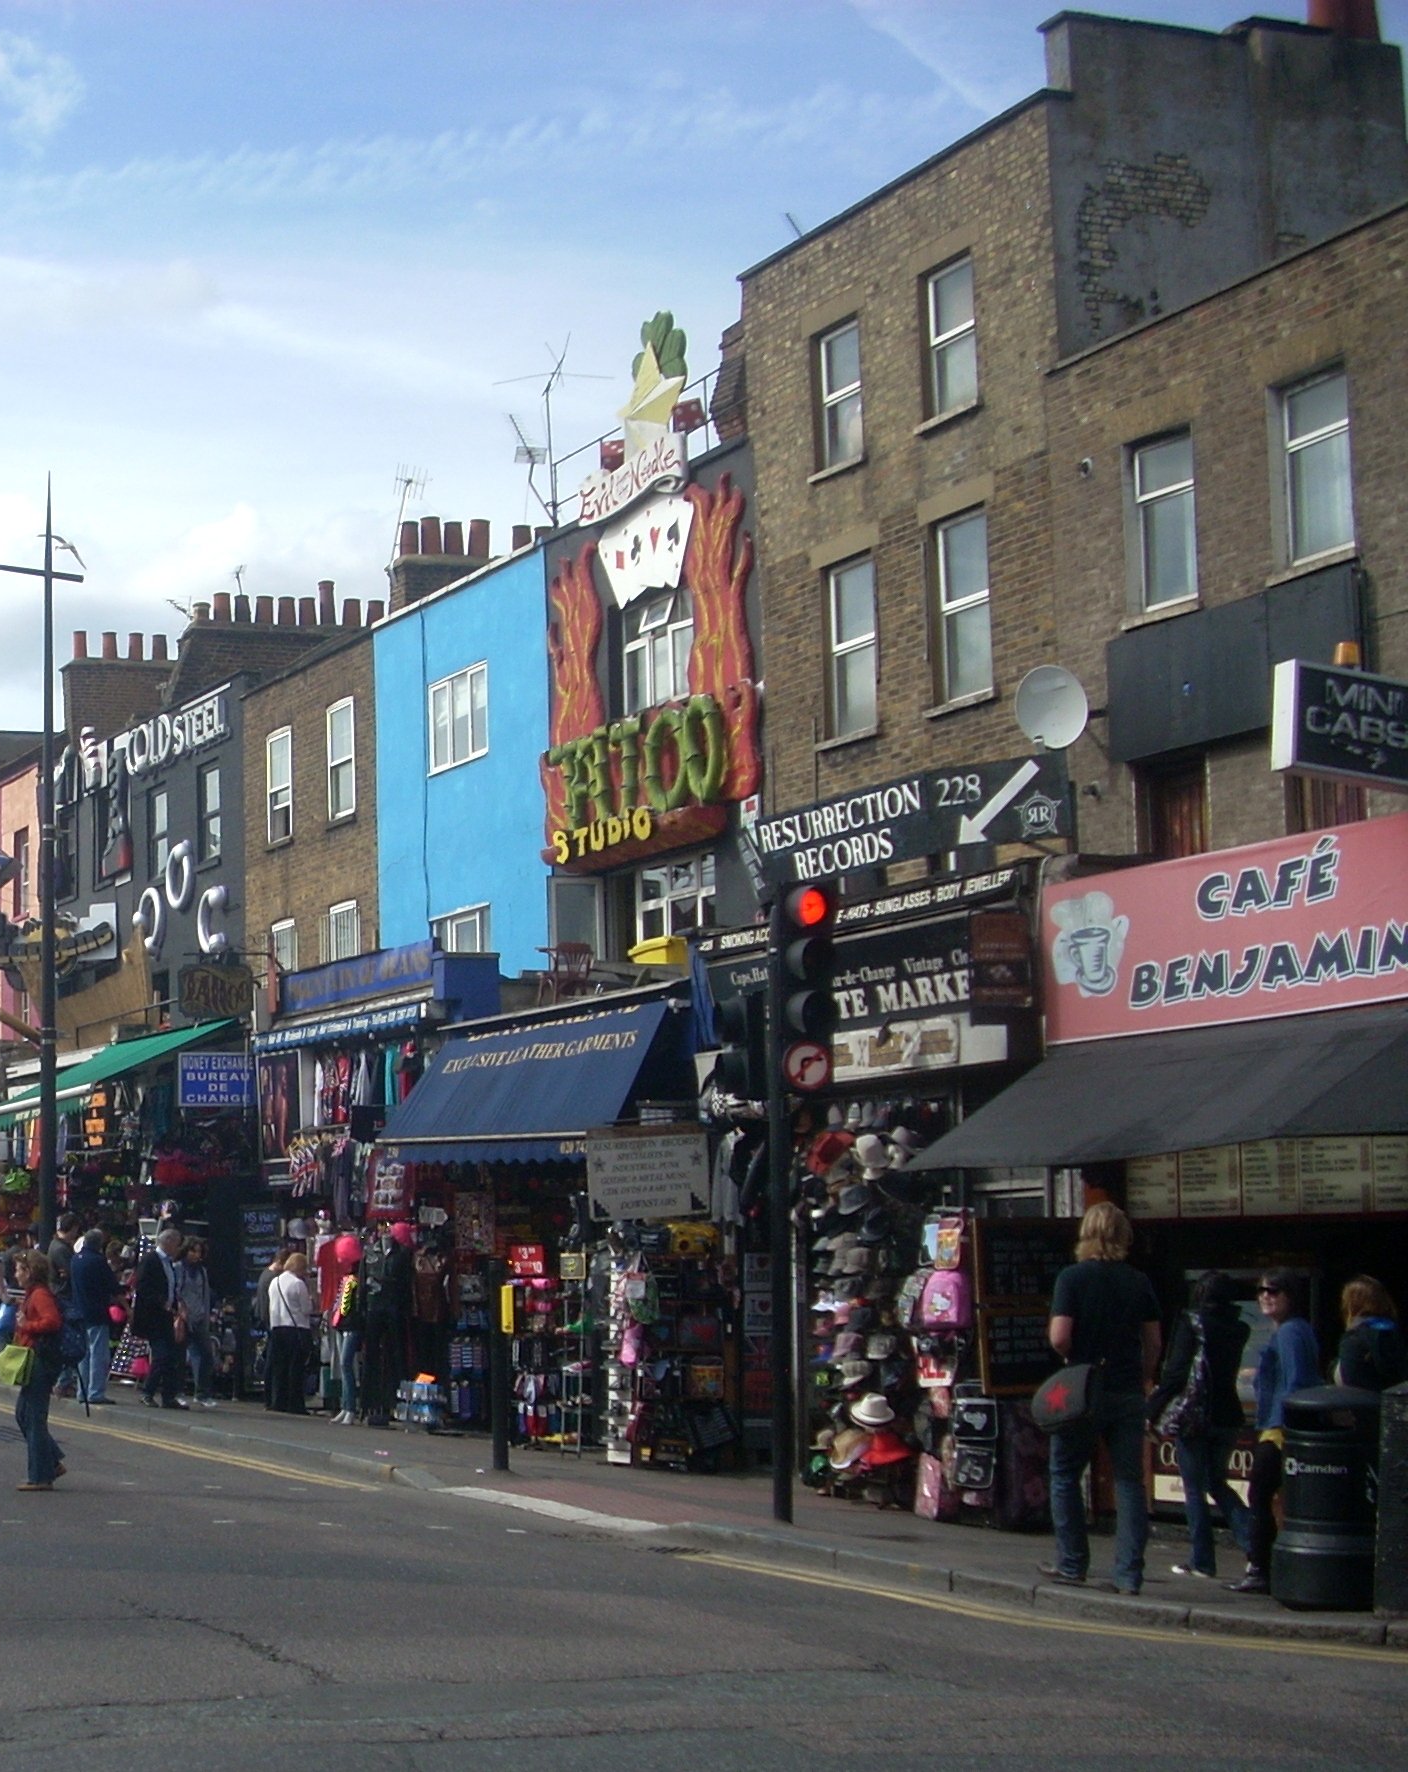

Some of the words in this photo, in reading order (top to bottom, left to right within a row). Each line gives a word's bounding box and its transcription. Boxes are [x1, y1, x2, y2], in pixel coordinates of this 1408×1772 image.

[580, 475, 618, 520] Evil
[628, 437, 681, 499] Needle
[1325, 678, 1405, 716] MINI
[126, 714, 171, 776] COLD
[172, 695, 226, 756] STEEL
[548, 694, 724, 829] TATTOO
[759, 781, 921, 853] RESURRECTION
[936, 773, 982, 807] 228
[794, 827, 893, 880] RECORDS
[875, 890, 931, 916] SUNGLASSES
[936, 883, 960, 903] BODY
[1196, 835, 1340, 921] CAFÉ
[720, 930, 754, 949] SMOKING
[755, 927, 770, 943] ACC
[903, 955, 943, 974] Vintage
[951, 949, 968, 966] Clo
[1129, 919, 1408, 1010] BENJAMIN
[833, 987, 868, 1021] TE
[879, 968, 970, 1014] MARKE
[183, 1056, 210, 1070] MONEY
[442, 1051, 506, 1074] EXCLUSIVE
[506, 1041, 564, 1065] LEATHER
[565, 1031, 638, 1057] GARMENTS
[186, 1072, 250, 1082] BUREAU
[208, 1083, 228, 1092] DE
[1297, 1462, 1348, 1474] Camden
